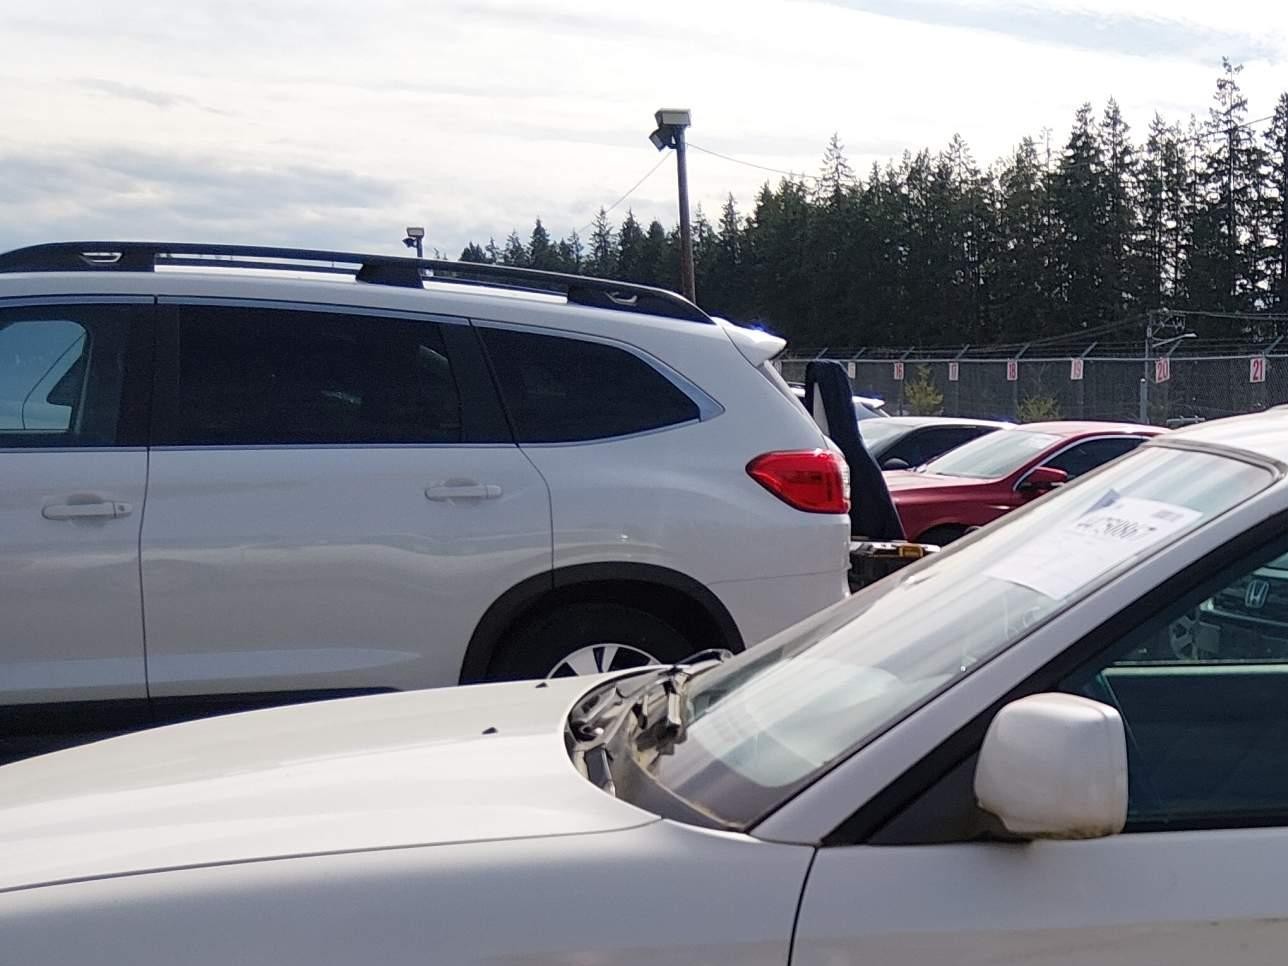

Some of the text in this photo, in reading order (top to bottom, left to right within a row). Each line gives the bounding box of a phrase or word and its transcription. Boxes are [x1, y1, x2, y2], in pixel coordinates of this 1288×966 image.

[1008, 361, 1017, 379] 18
[1072, 361, 1082, 378] 19
[1156, 360, 1168, 381] 20
[1252, 359, 1264, 381] 21
